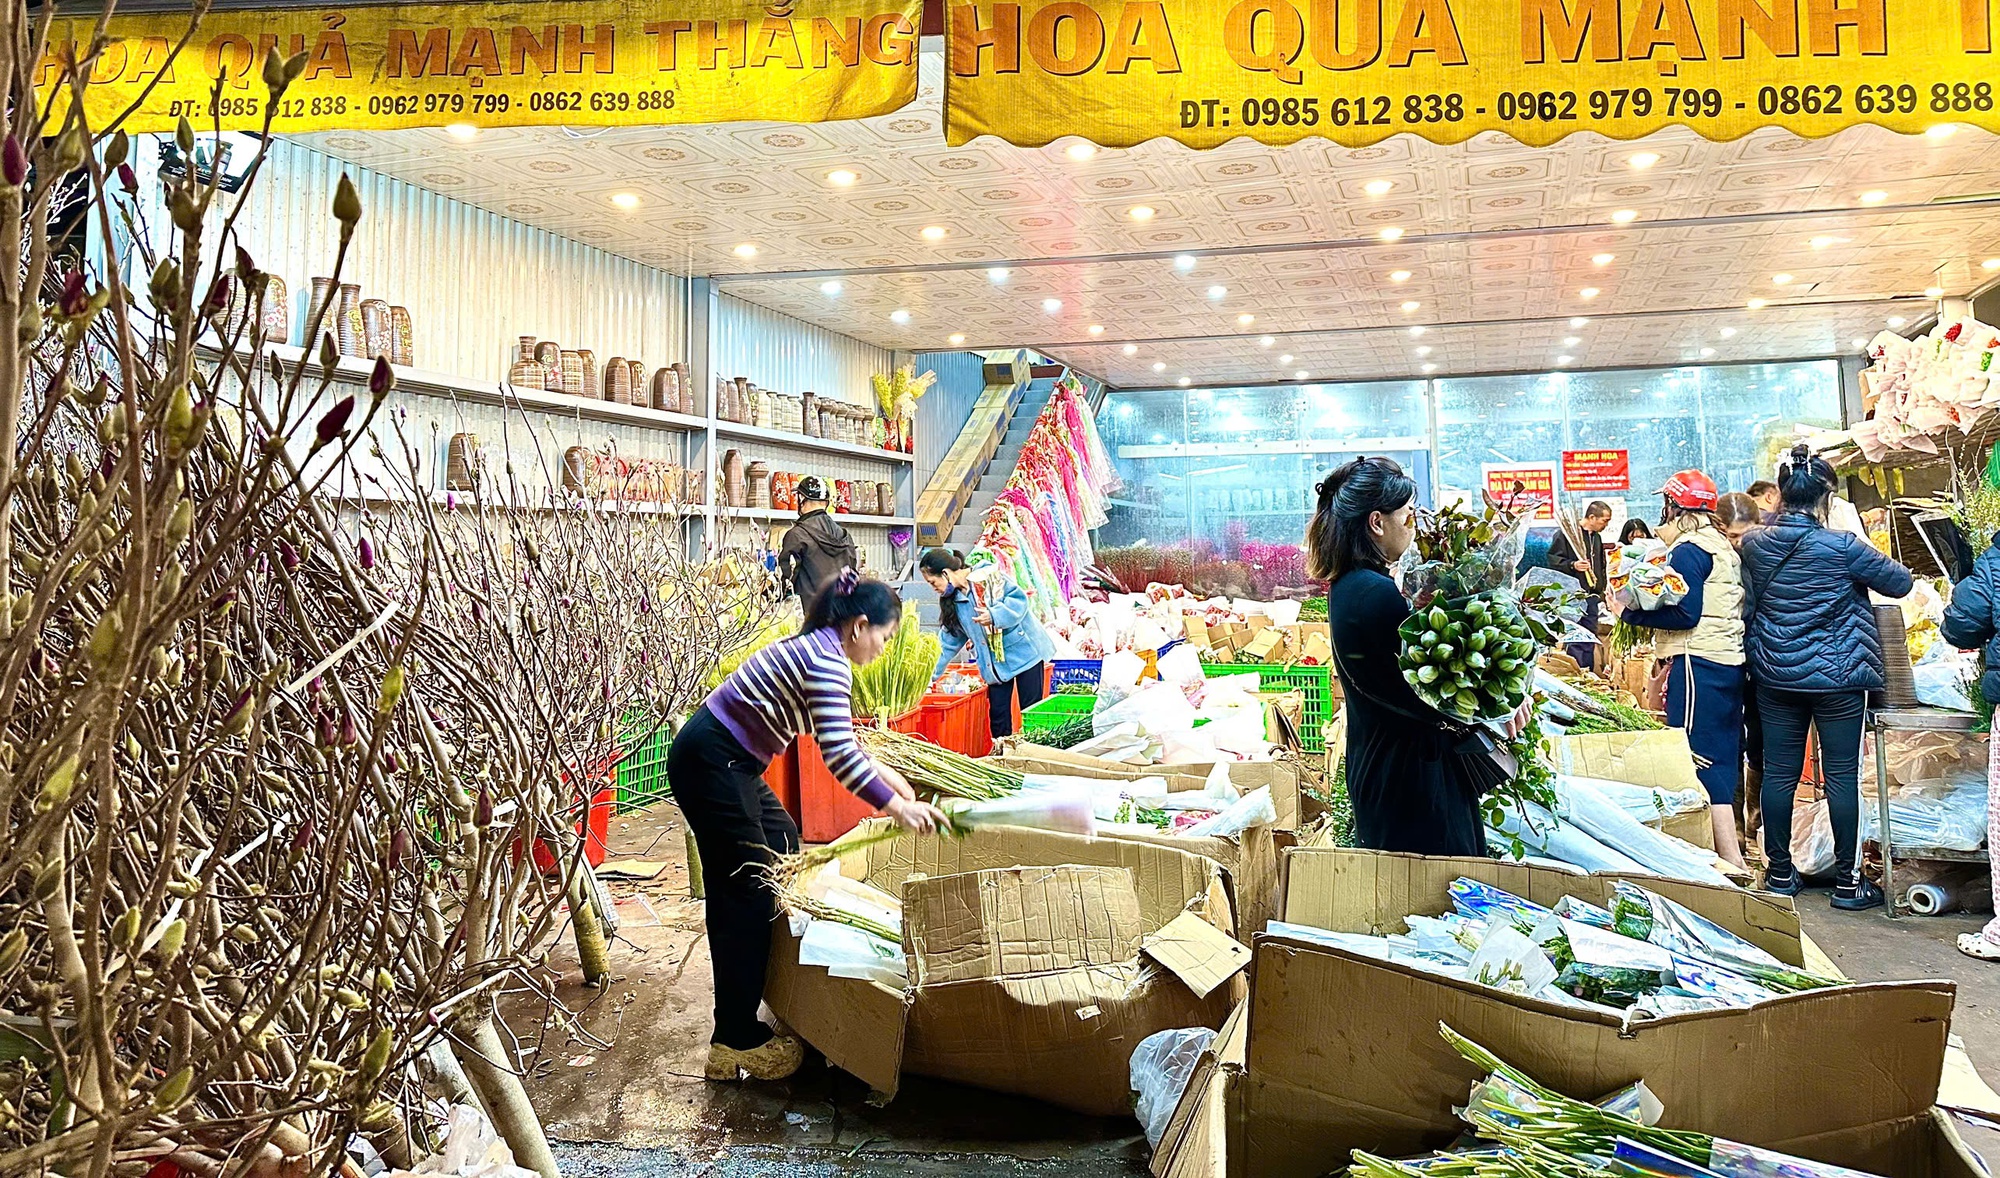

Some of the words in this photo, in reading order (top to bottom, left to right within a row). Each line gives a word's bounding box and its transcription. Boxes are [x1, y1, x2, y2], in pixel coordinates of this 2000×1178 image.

[387, 26, 614, 87] MẠNH
[954, 0, 1181, 76] HOA
[1521, 0, 1889, 77] MẠNH
[168, 100, 201, 118] ĐT:
[311, 96, 347, 116] 838
[368, 95, 419, 116] 0962
[424, 93, 464, 114] 979
[472, 93, 509, 114] 799
[529, 92, 581, 112] 0862
[589, 91, 630, 111] 639
[637, 90, 675, 110] 888
[1179, 101, 1230, 128] ĐT:
[1241, 99, 1319, 127] 0985
[1331, 97, 1391, 125] 612
[1402, 94, 1464, 122] 838
[1498, 92, 1577, 121] 0962
[1589, 89, 1653, 118] 979
[1664, 87, 1722, 117] 799
[1758, 86, 1843, 114] 0862
[1855, 84, 1918, 113] 639
[1929, 82, 1993, 111] 888
[1573, 453, 1599, 461] MẠNH
[1601, 452, 1618, 460] HOA
